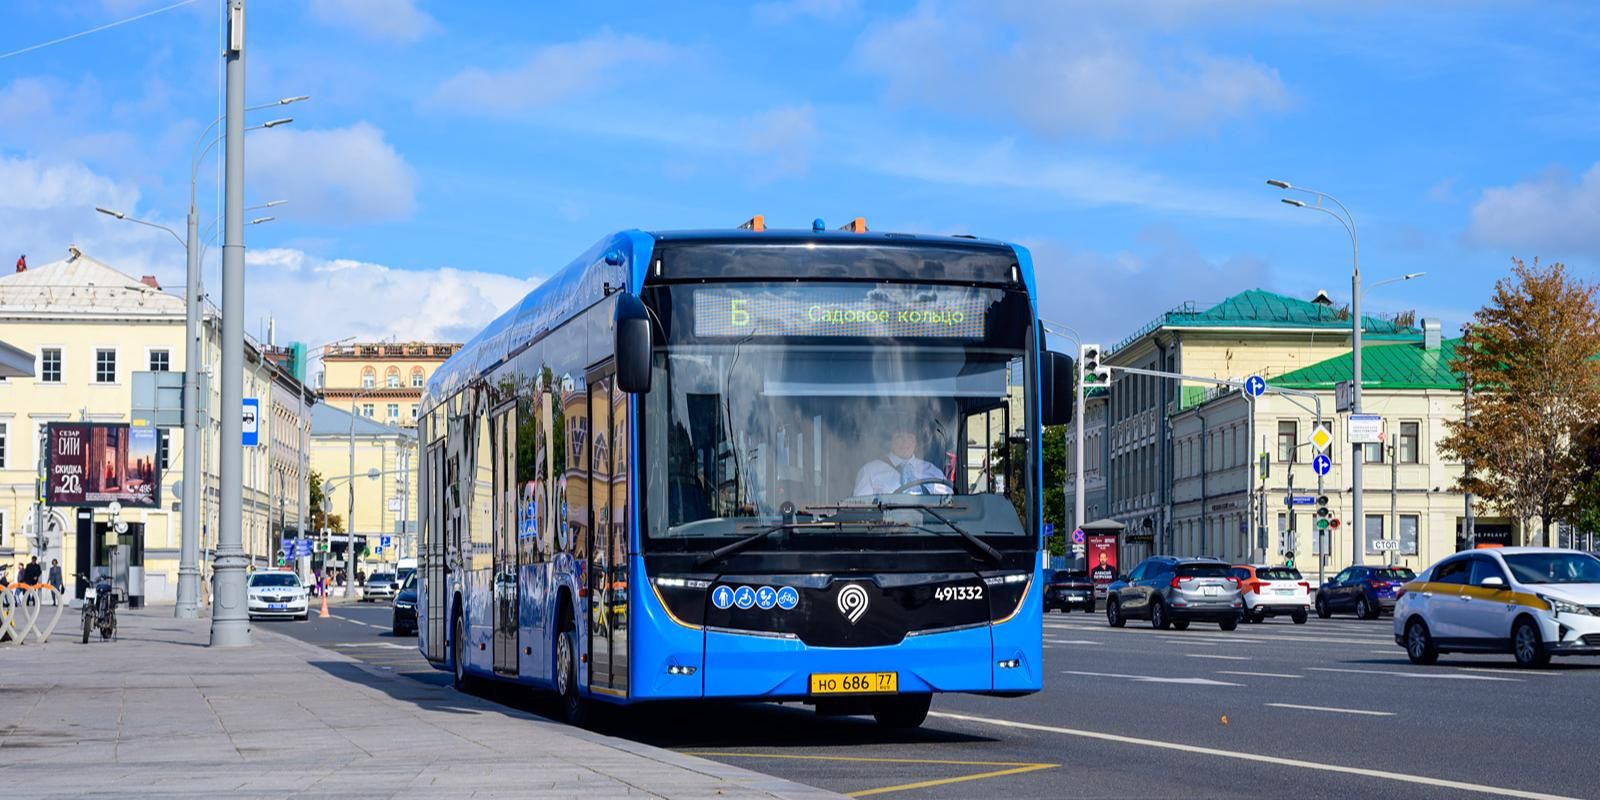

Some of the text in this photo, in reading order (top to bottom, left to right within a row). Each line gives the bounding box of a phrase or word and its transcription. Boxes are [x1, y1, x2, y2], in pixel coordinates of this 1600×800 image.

[731, 299, 965, 326] Б Садовое кольцо
[58, 437, 80, 456] СИТИ
[55, 464, 82, 474] СКИДКА
[1375, 541, 1397, 549] СТОП
[934, 586, 983, 601] 491332
[818, 674, 892, 690] НО 686 77
